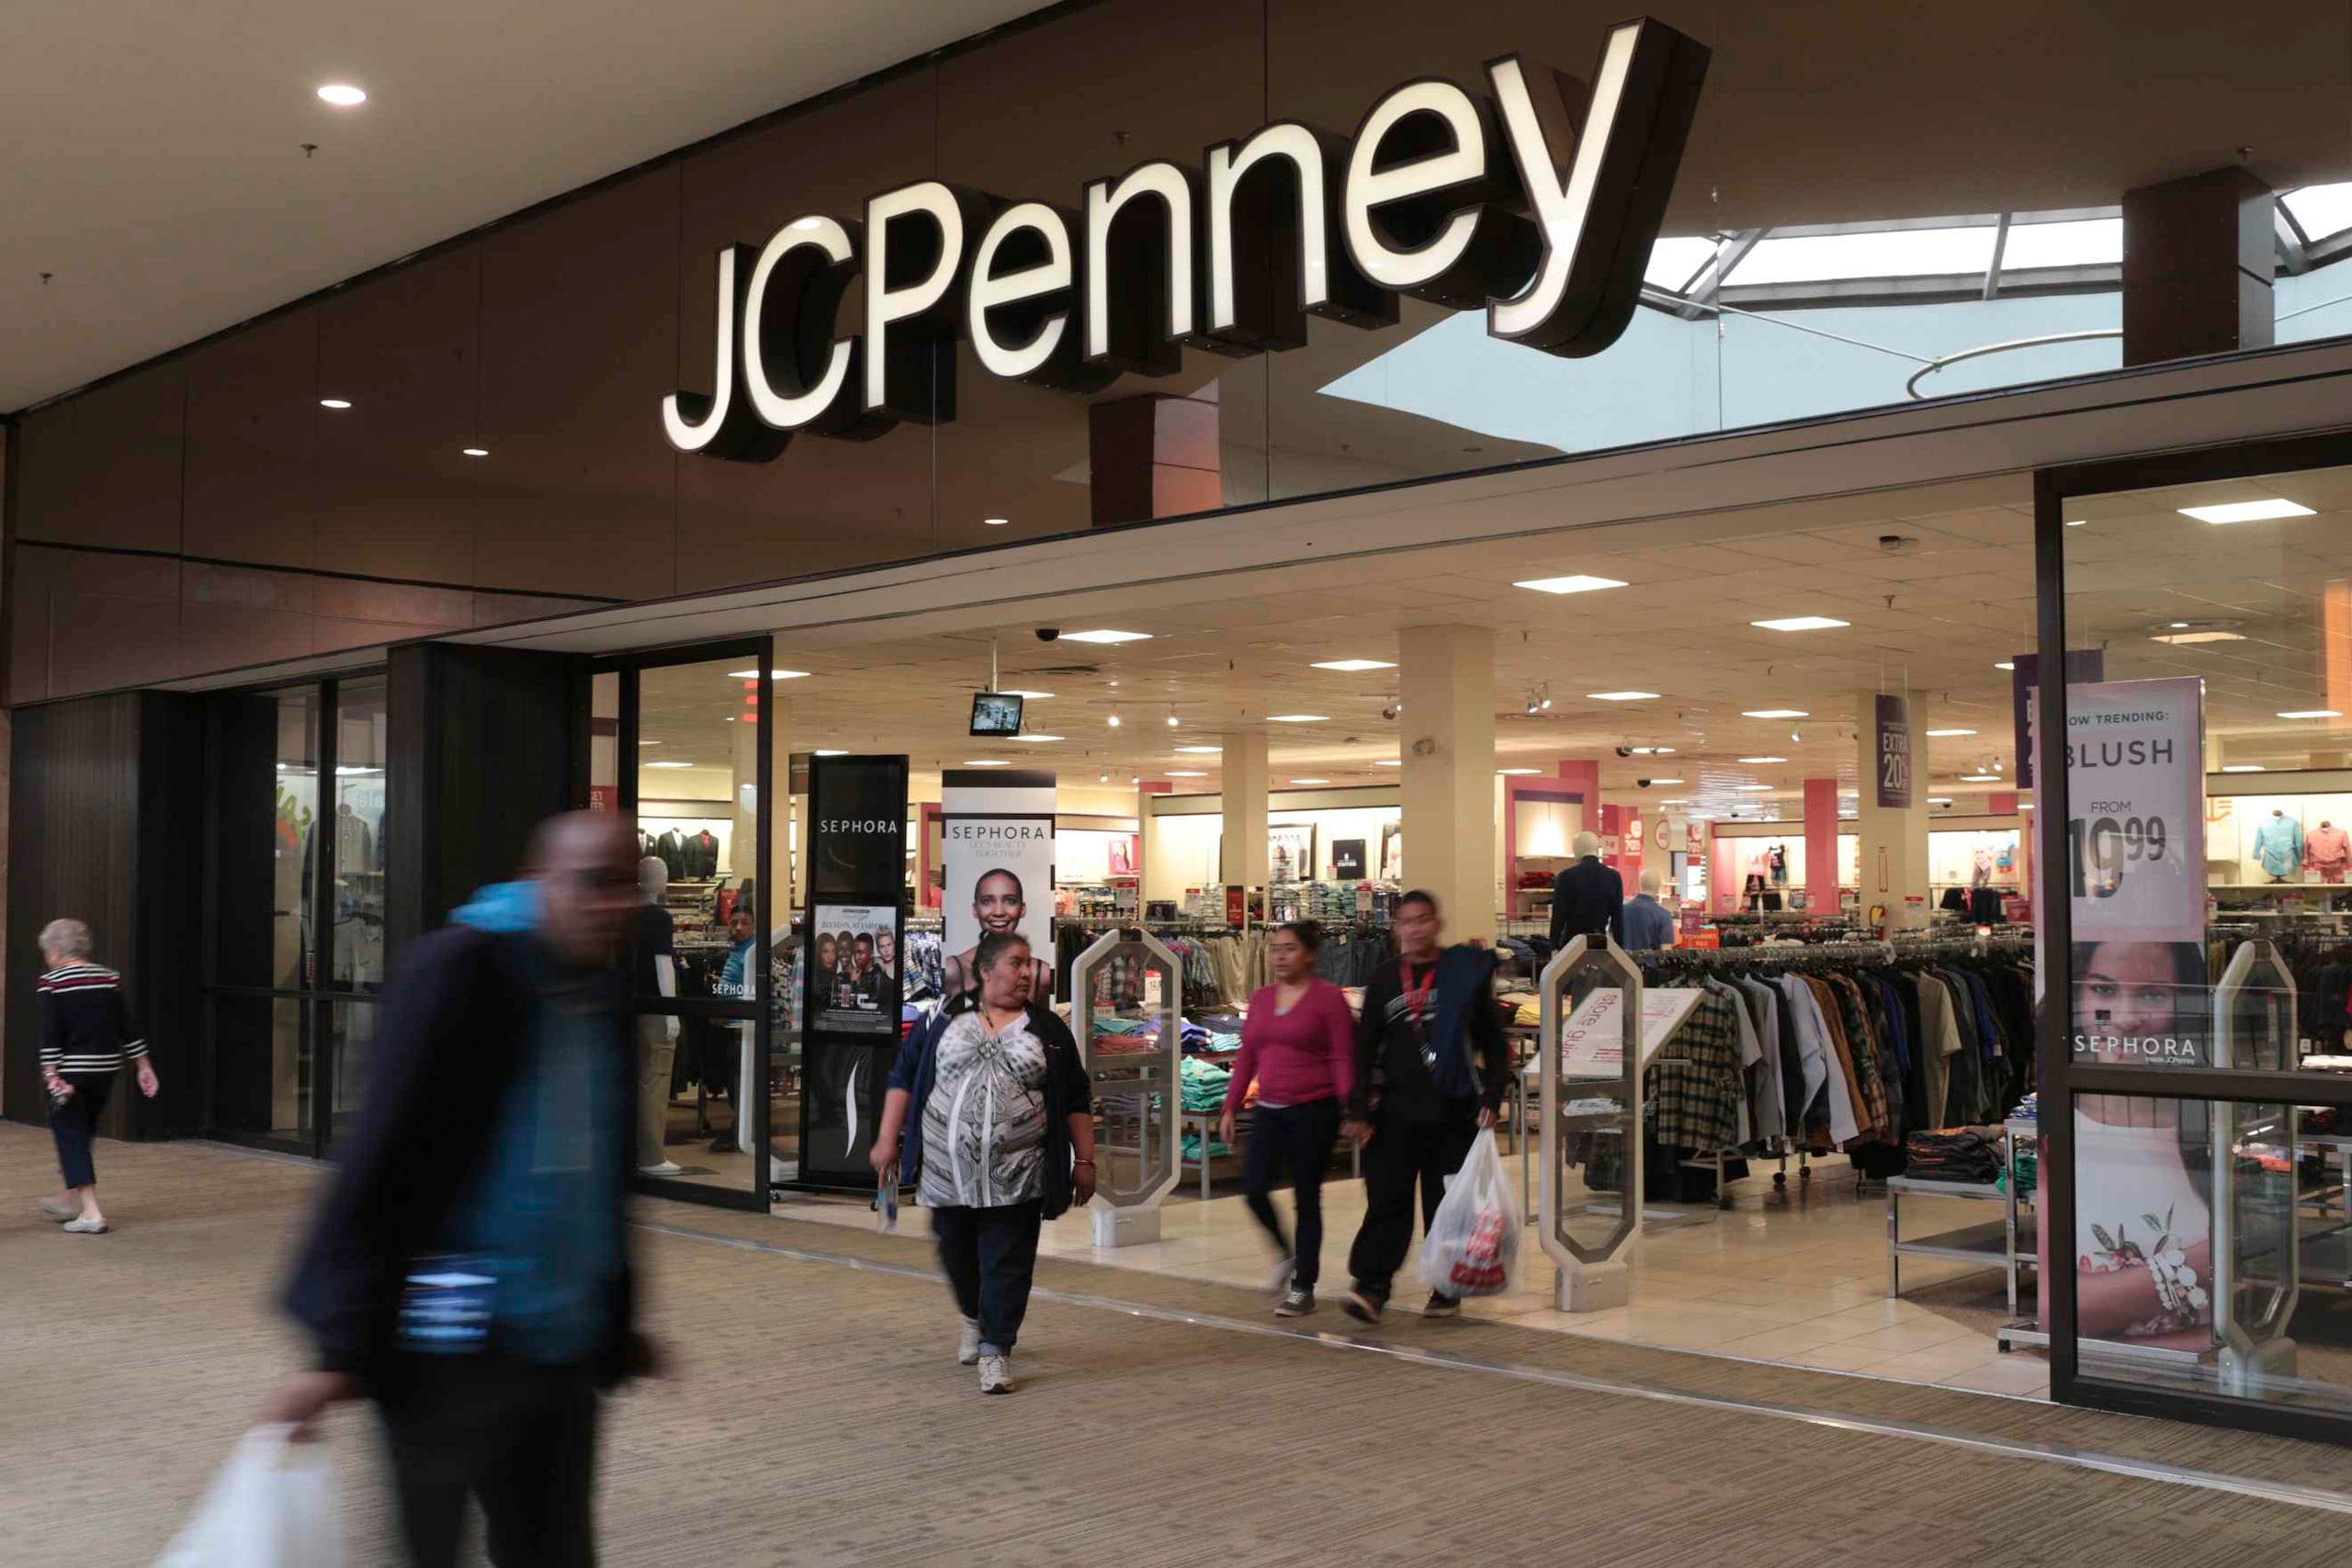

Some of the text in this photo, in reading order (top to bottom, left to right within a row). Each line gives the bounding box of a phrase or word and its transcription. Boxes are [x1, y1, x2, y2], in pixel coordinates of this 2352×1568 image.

[661, 17, 1647, 453] JCPenney
[2068, 711, 2169, 726] OW TRENDING:
[1883, 733, 1910, 752] EXTRA
[2090, 802, 2132, 813] FROM
[820, 820, 898, 833] SEPHORA
[952, 826, 1045, 840] SEPHORA
[712, 984, 756, 995] SEPHORA
[2074, 1035, 2196, 1056] SEPHORA
